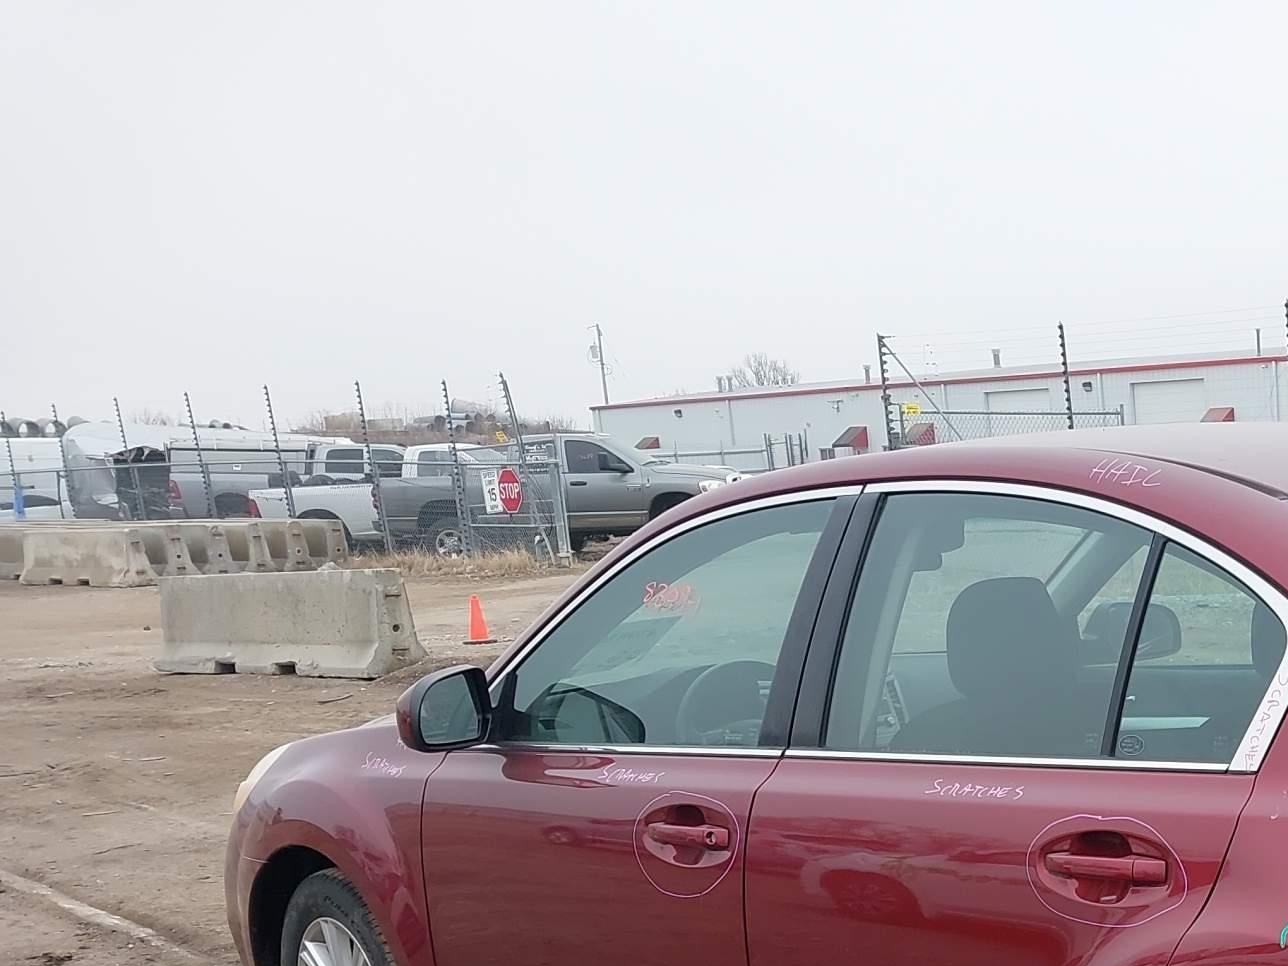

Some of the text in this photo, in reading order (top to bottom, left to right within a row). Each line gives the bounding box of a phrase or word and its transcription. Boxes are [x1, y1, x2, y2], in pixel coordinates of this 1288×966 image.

[1088, 457, 1163, 488] HAIL
[487, 487, 498, 502] 15
[499, 482, 520, 499] STOP
